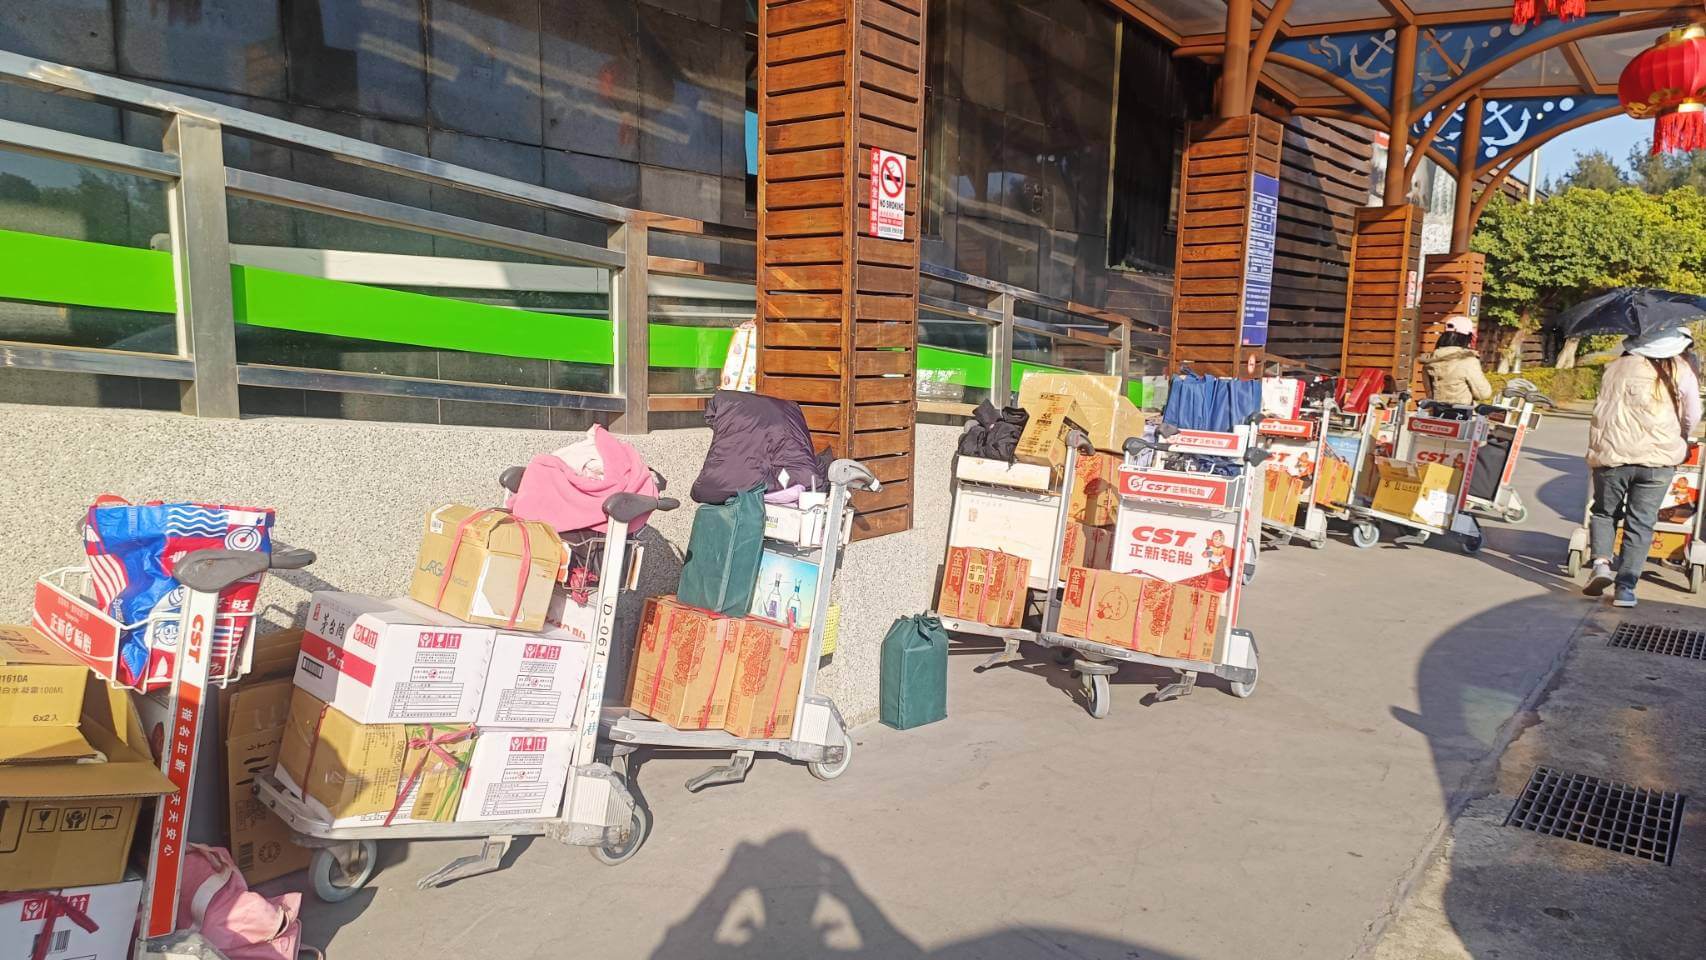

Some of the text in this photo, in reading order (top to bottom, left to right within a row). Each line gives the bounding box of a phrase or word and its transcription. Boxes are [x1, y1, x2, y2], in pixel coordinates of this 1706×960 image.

[886, 200, 904, 211] SMOKING
[1417, 451, 1449, 463] CST
[1146, 483, 1205, 497] CST 正新轮胎
[1132, 525, 1197, 547] CST
[1128, 543, 1193, 566] 正新轮胎
[190, 614, 205, 664] CST
[596, 603, 613, 657] D-061
[174, 707, 193, 772] 指名正新
[163, 793, 181, 856] 天天安心
